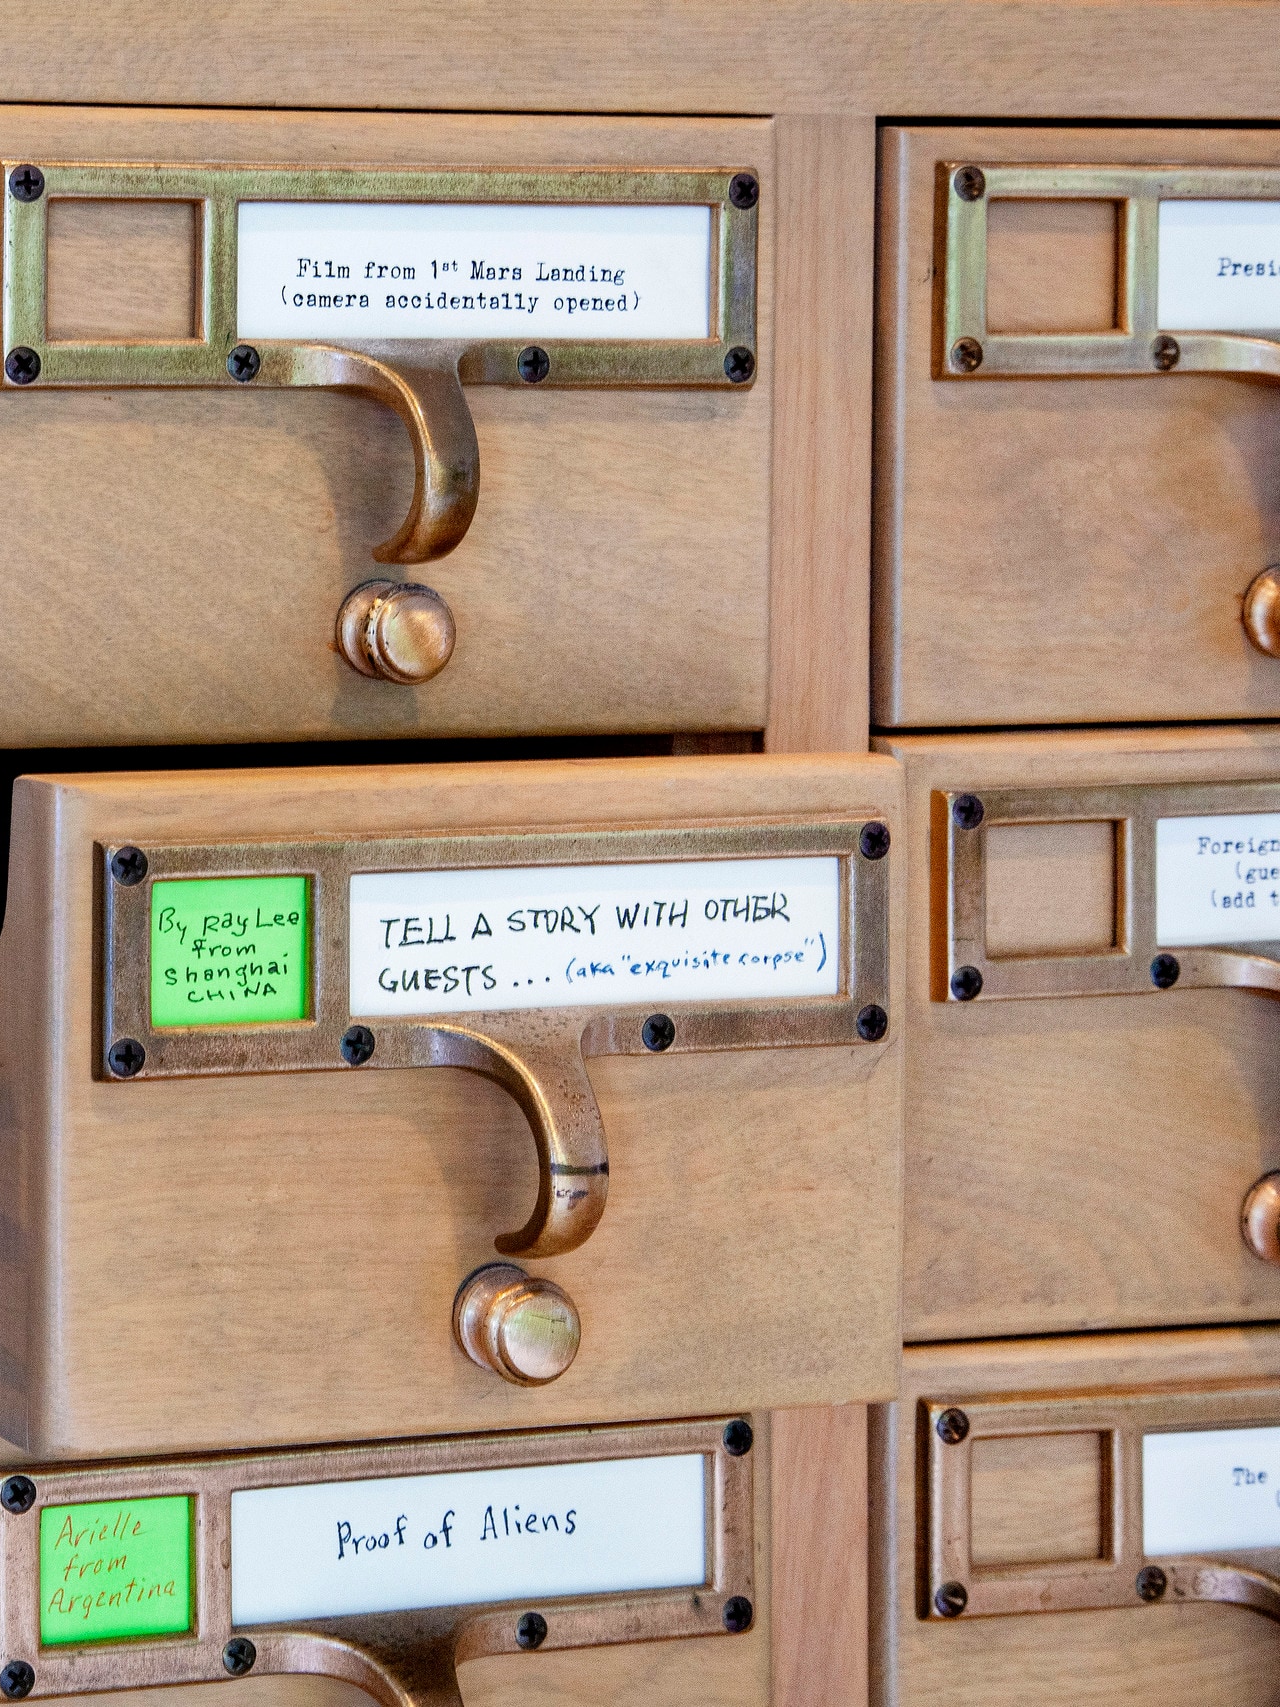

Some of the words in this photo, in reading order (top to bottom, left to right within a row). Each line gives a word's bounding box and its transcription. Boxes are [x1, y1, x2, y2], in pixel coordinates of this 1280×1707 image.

[296, 258, 350, 279] Film
[363, 261, 416, 280] from
[431, 260, 459, 280] 1st
[470, 261, 522, 281] Mars
[535, 262, 626, 286] Landing
[1217, 257, 1280, 277] Presi
[281, 286, 370, 309] (camera
[385, 292, 540, 312] accidentally
[553, 292, 641, 314] opened)
[1211, 890, 1256, 908] (add
[159, 907, 187, 945] By
[256, 908, 299, 928] Lee
[380, 917, 456, 948] TELL
[471, 914, 493, 938] A
[507, 904, 601, 935] STORY
[616, 901, 688, 929] WITH
[704, 892, 791, 923] OTHER
[192, 939, 256, 959] from
[378, 965, 497, 996] GUESTS
[565, 957, 616, 984] (aka
[187, 981, 277, 1003] CHINA
[1232, 1466, 1267, 1487] The
[54, 1511, 146, 1550] Arielle
[337, 1514, 408, 1559] Proof
[423, 1511, 455, 1548] of
[480, 1505, 577, 1541] Aliens
[63, 1554, 127, 1582] from
[47, 1577, 176, 1620] Argentina
